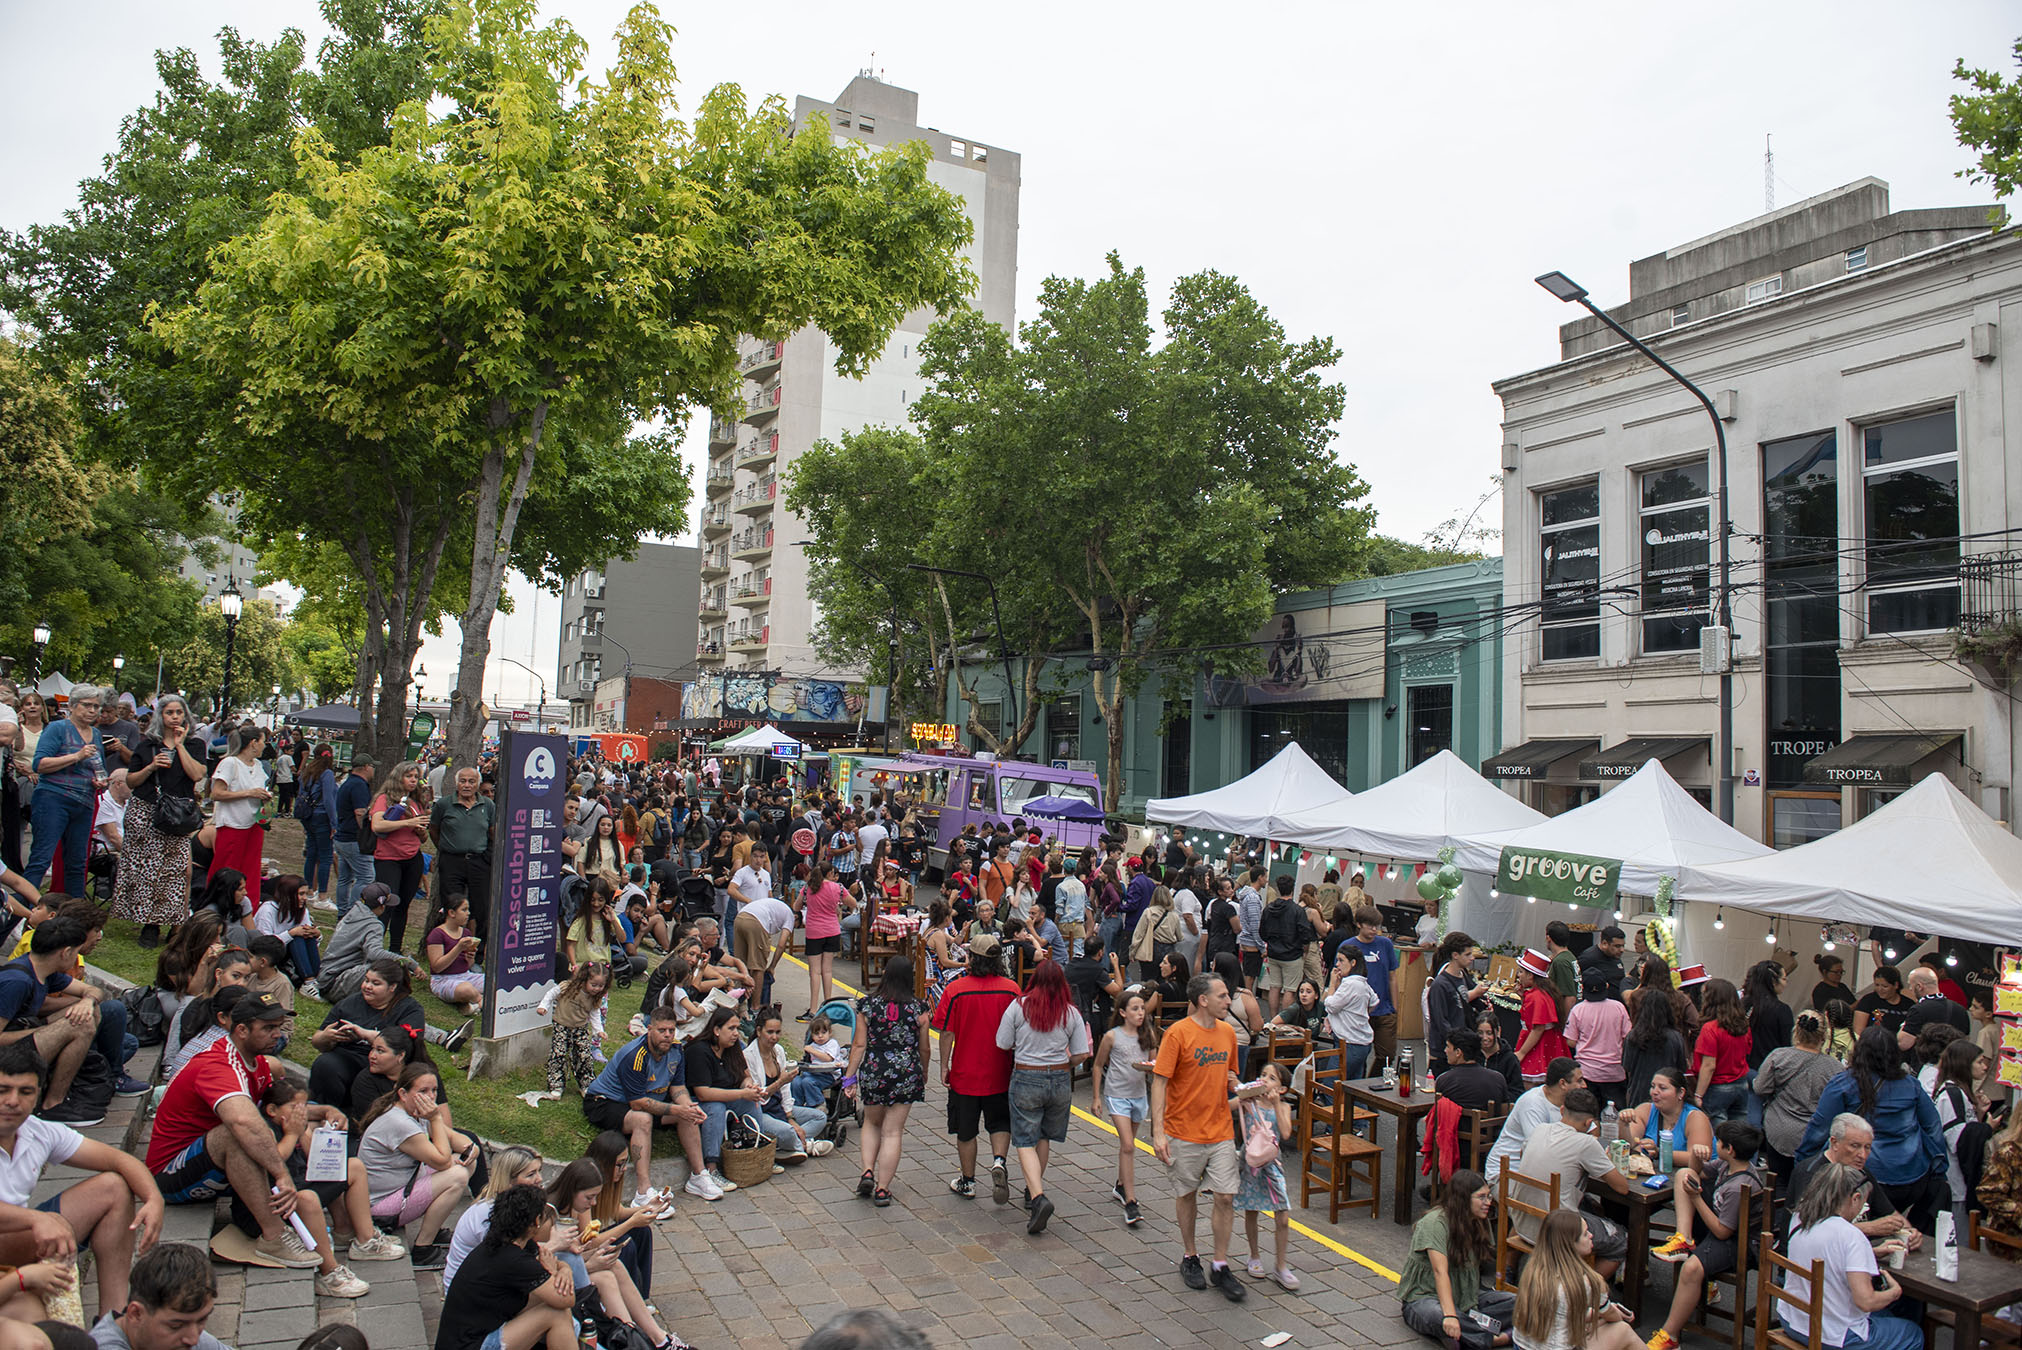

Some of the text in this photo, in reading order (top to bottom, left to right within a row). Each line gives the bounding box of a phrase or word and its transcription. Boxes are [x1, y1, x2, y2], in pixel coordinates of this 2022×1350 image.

[718, 720, 742, 728] CRAFT
[1771, 741, 1835, 755] TROPEA
[1496, 766, 1531, 775] TROPEA
[1597, 766, 1638, 776] TROPEA
[1827, 769, 1882, 781] TROPEA
[1508, 854, 1607, 886] groove
[504, 809, 527, 949] Descubrila
[1573, 885, 1600, 901] Café
[511, 953, 546, 965] Vas a querer
[507, 964, 525, 975] volver
[499, 1003, 528, 1015] Campana
